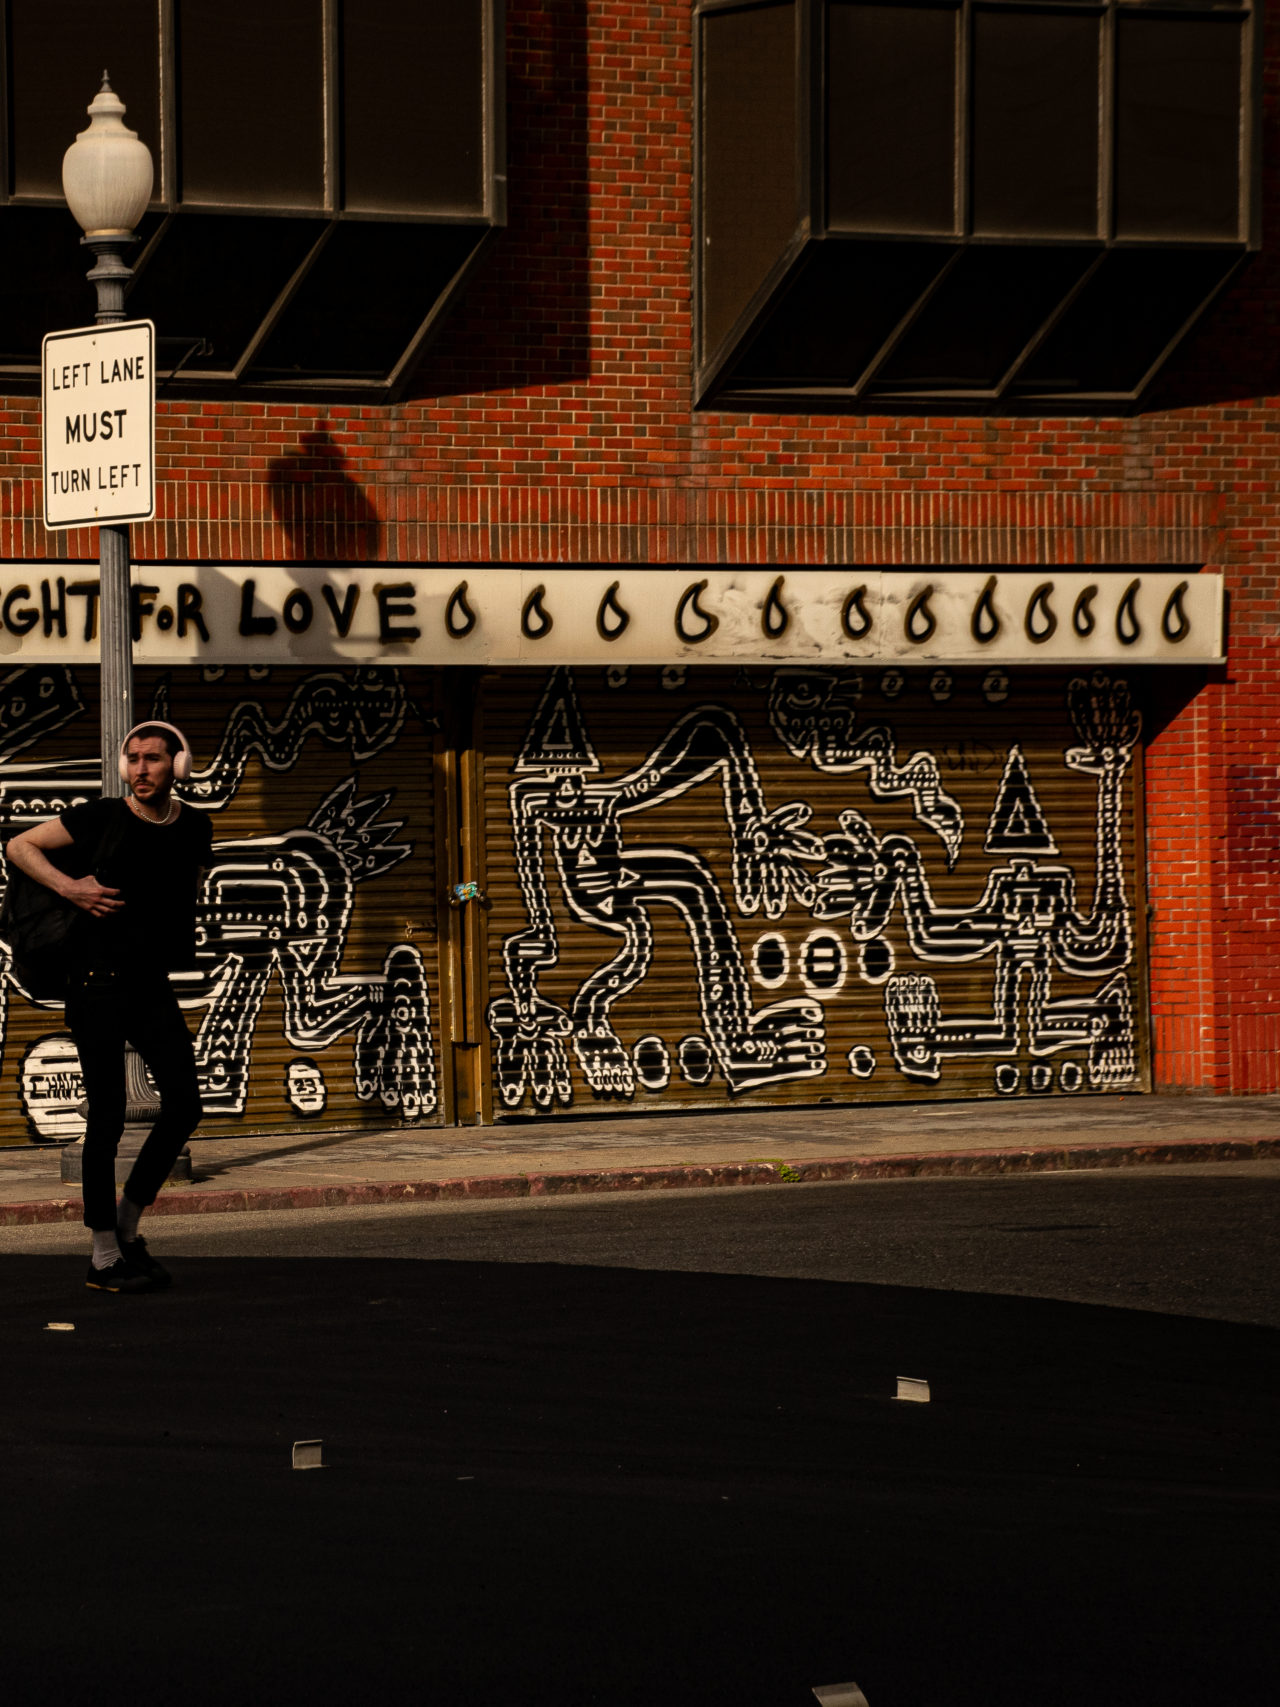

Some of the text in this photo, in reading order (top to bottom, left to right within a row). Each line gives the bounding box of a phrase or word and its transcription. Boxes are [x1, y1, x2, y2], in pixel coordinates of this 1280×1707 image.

[53, 356, 145, 391] LEFT LANE
[66, 409, 127, 444] MUST
[51, 464, 141, 494] TURN LEFT
[238, 579, 421, 644] LOVE
